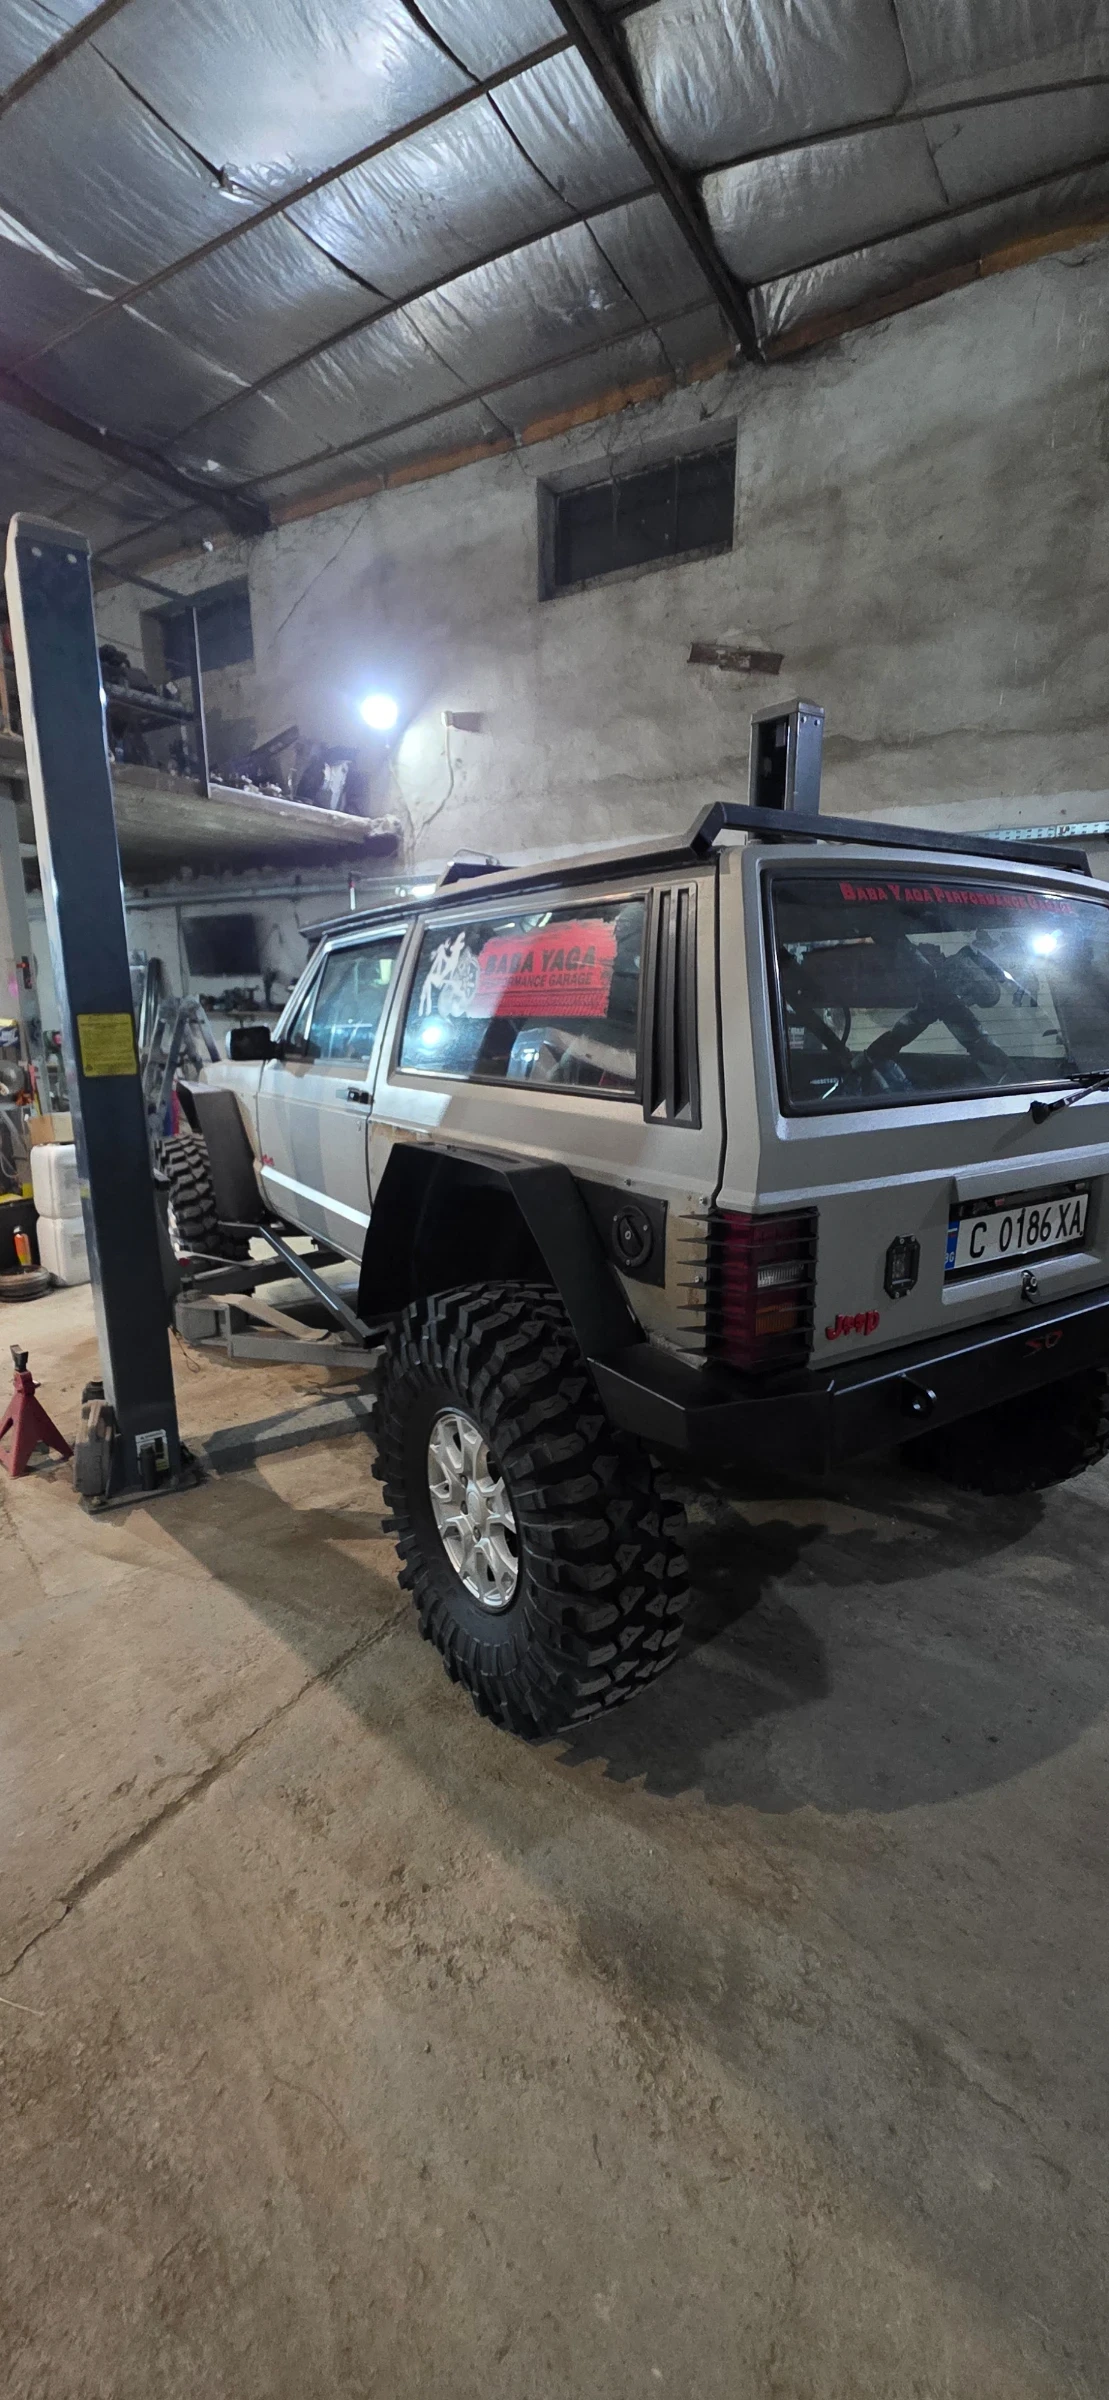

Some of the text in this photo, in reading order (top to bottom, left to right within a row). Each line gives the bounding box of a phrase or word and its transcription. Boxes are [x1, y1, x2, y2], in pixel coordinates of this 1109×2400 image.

[840, 882, 887, 901] BABA
[886, 883, 933, 903] YAGA
[486, 946, 595, 975] BABA YAGA
[549, 973, 592, 986] GARAGE
[969, 1200, 1083, 1259] C 0186 XA
[825, 1310, 880, 1341] Jeep
